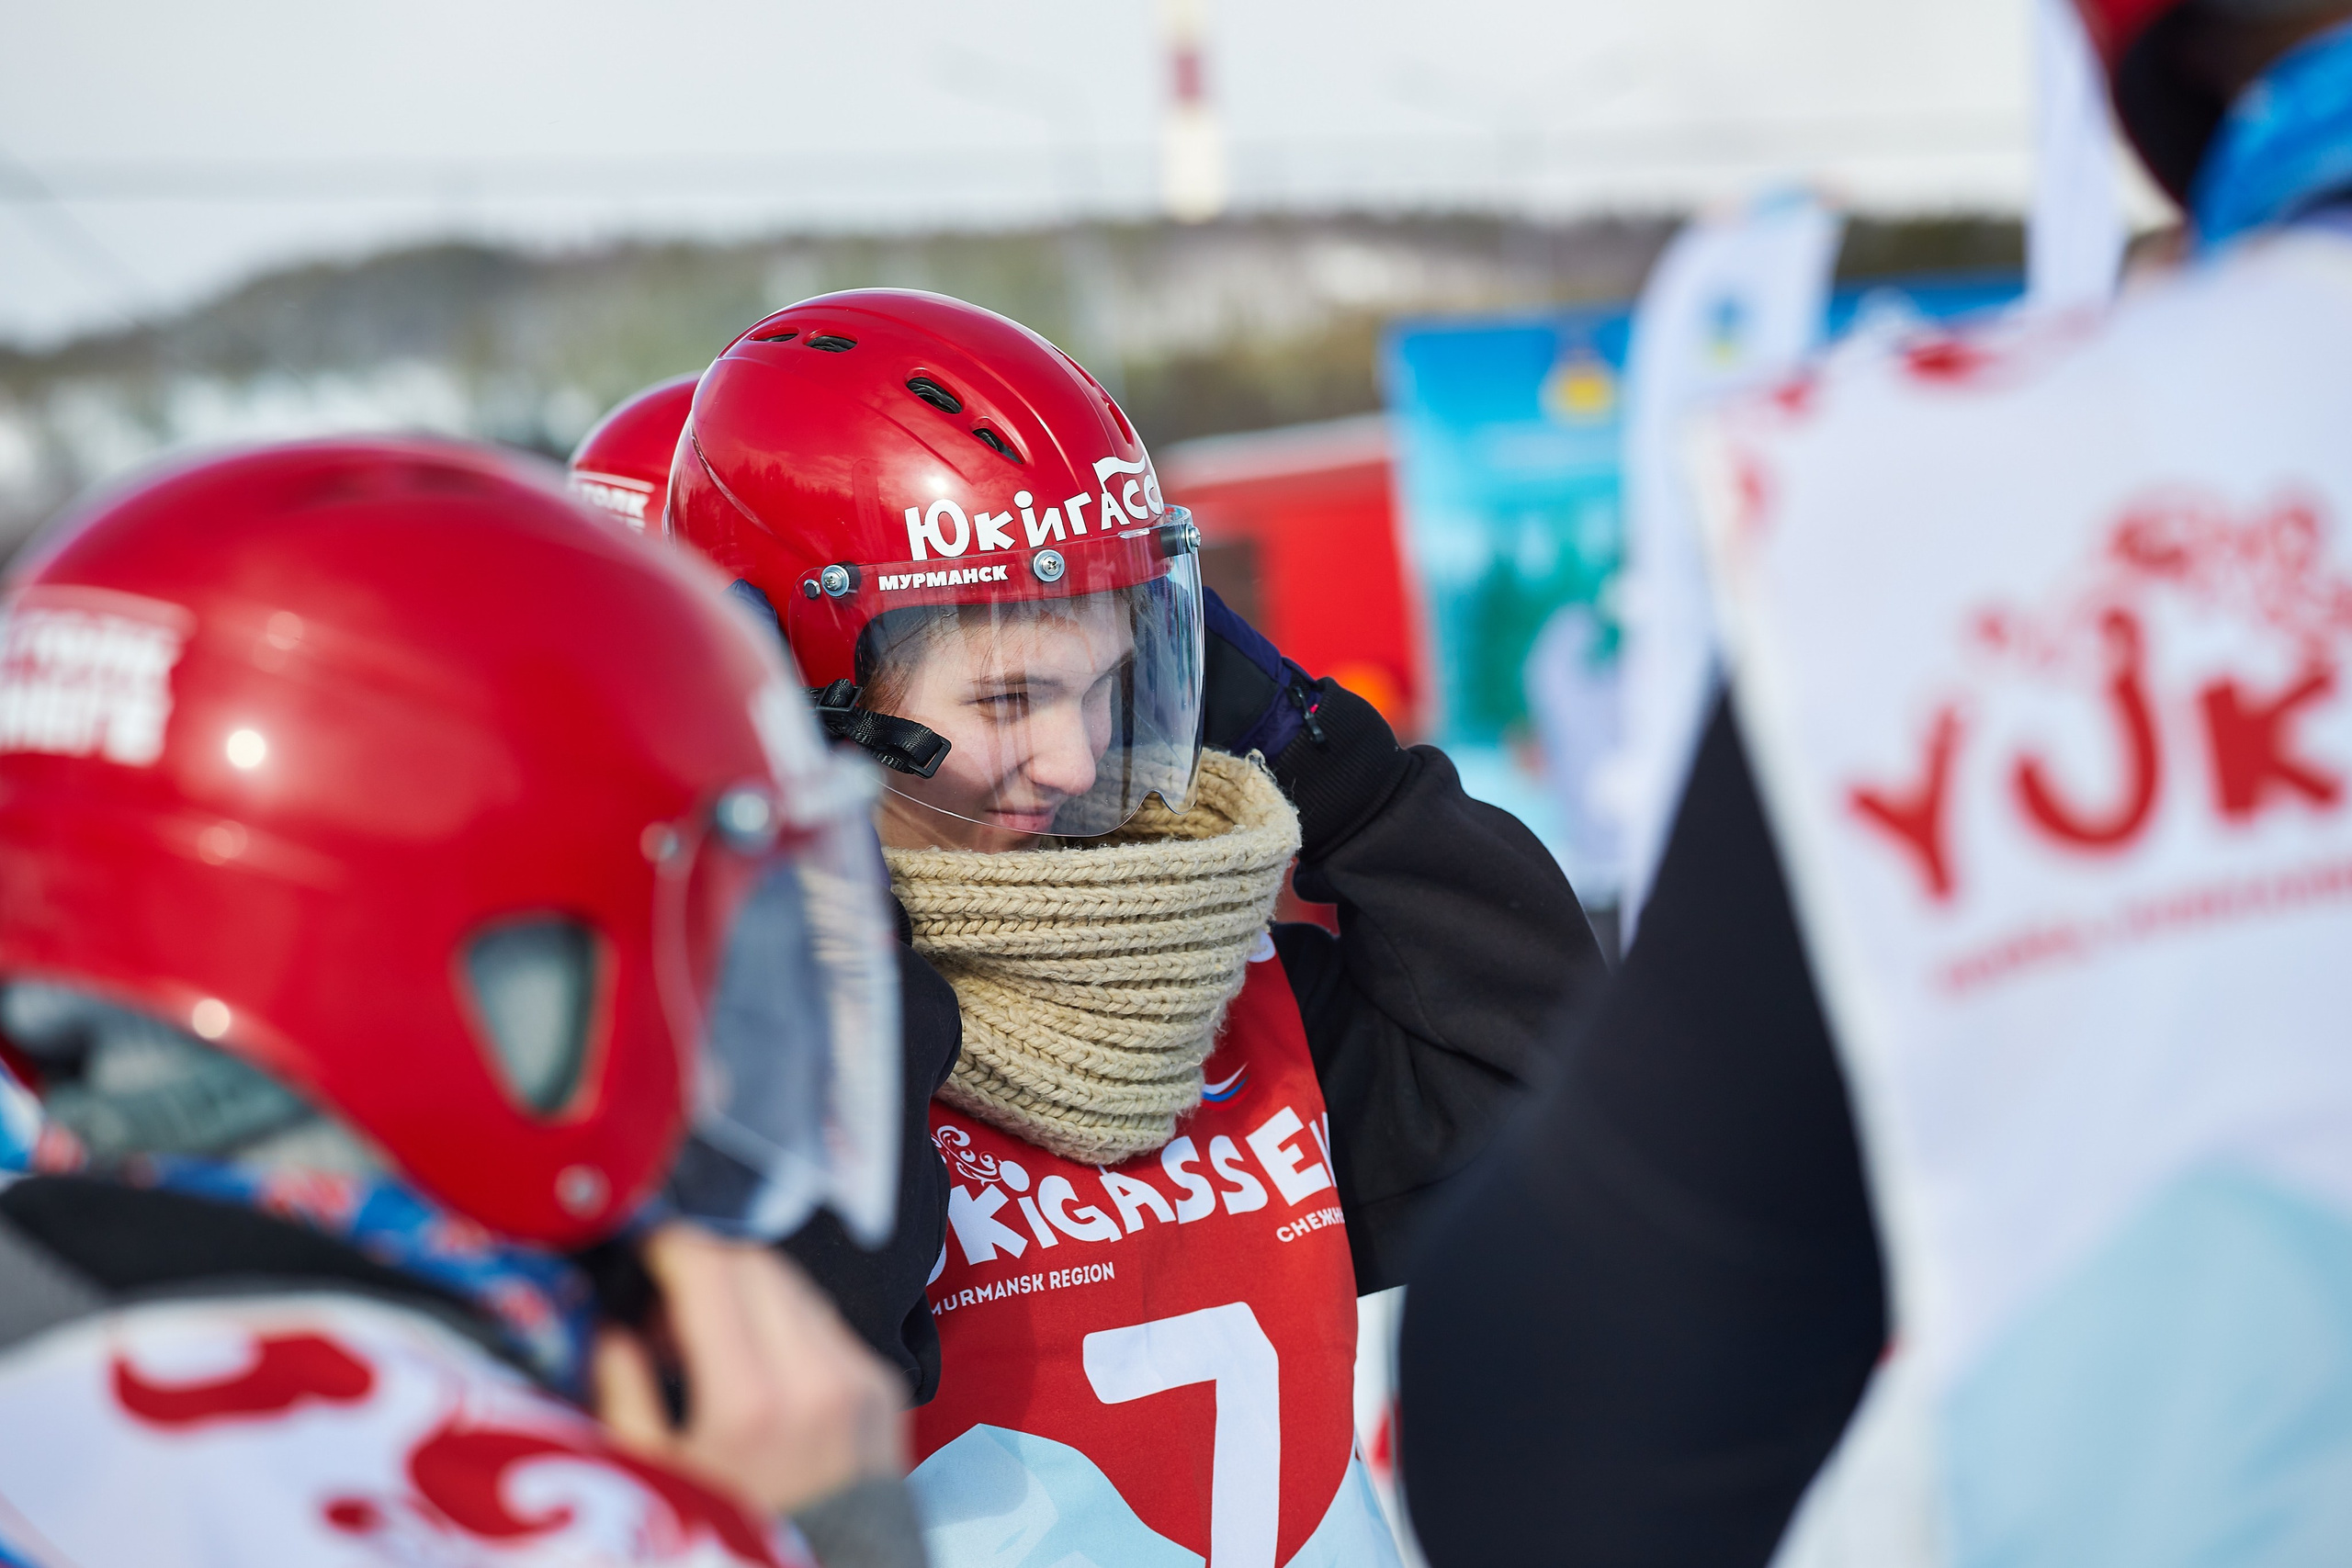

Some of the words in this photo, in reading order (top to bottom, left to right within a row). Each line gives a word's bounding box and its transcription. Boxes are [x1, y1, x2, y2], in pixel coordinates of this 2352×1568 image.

[878, 566, 1008, 592] МУРМАНСК
[1276, 1206, 1346, 1243] СНЕЖН
[1049, 1261, 1115, 1291] REGION
[1082, 1302, 1280, 1568] 7
